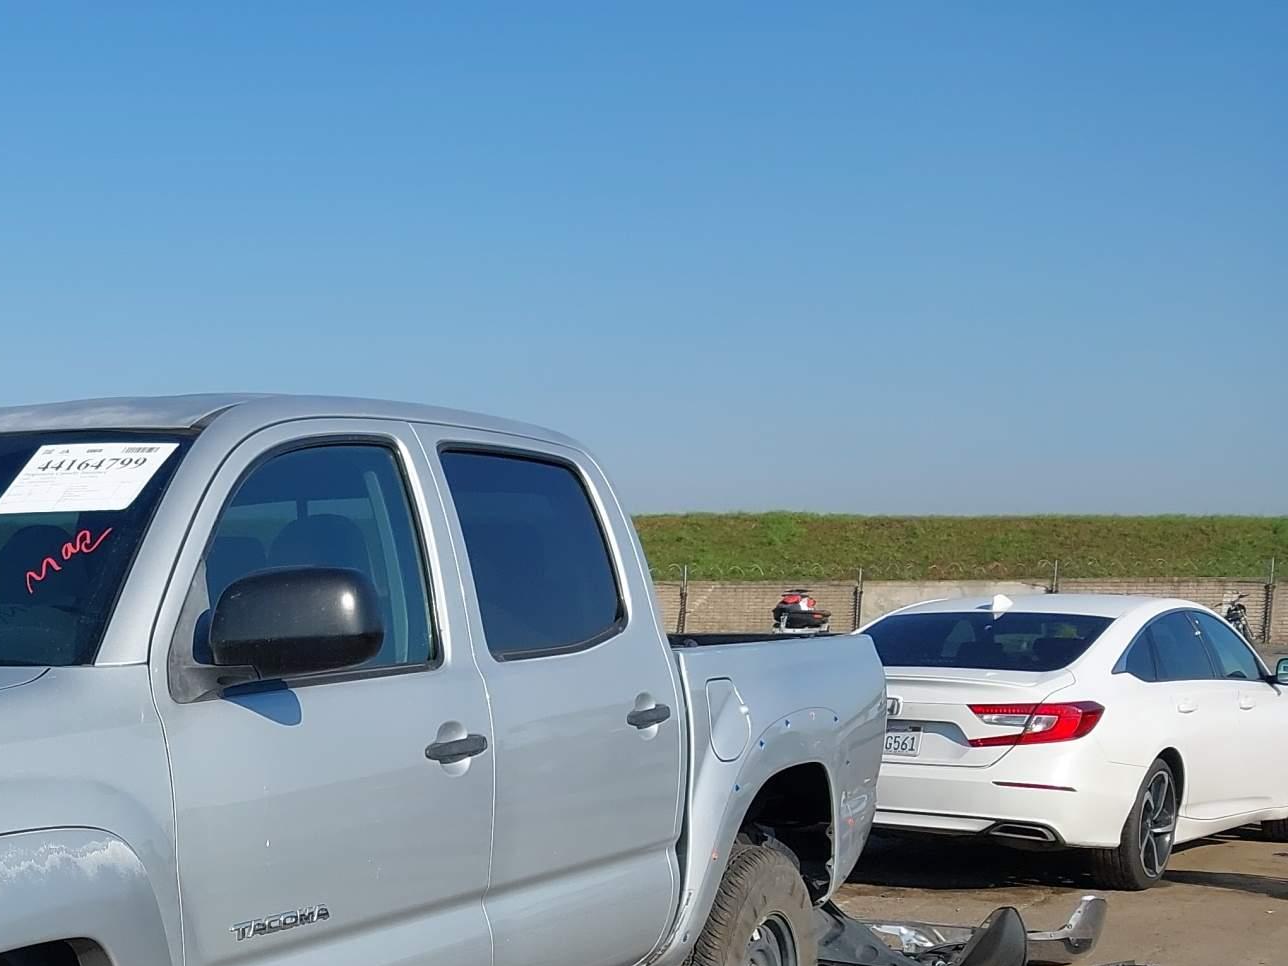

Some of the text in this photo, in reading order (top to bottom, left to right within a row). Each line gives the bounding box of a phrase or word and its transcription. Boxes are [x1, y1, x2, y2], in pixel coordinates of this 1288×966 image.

[37, 456, 148, 472] 44164799
[885, 735, 916, 752] G561
[230, 904, 330, 941] TACOMA
